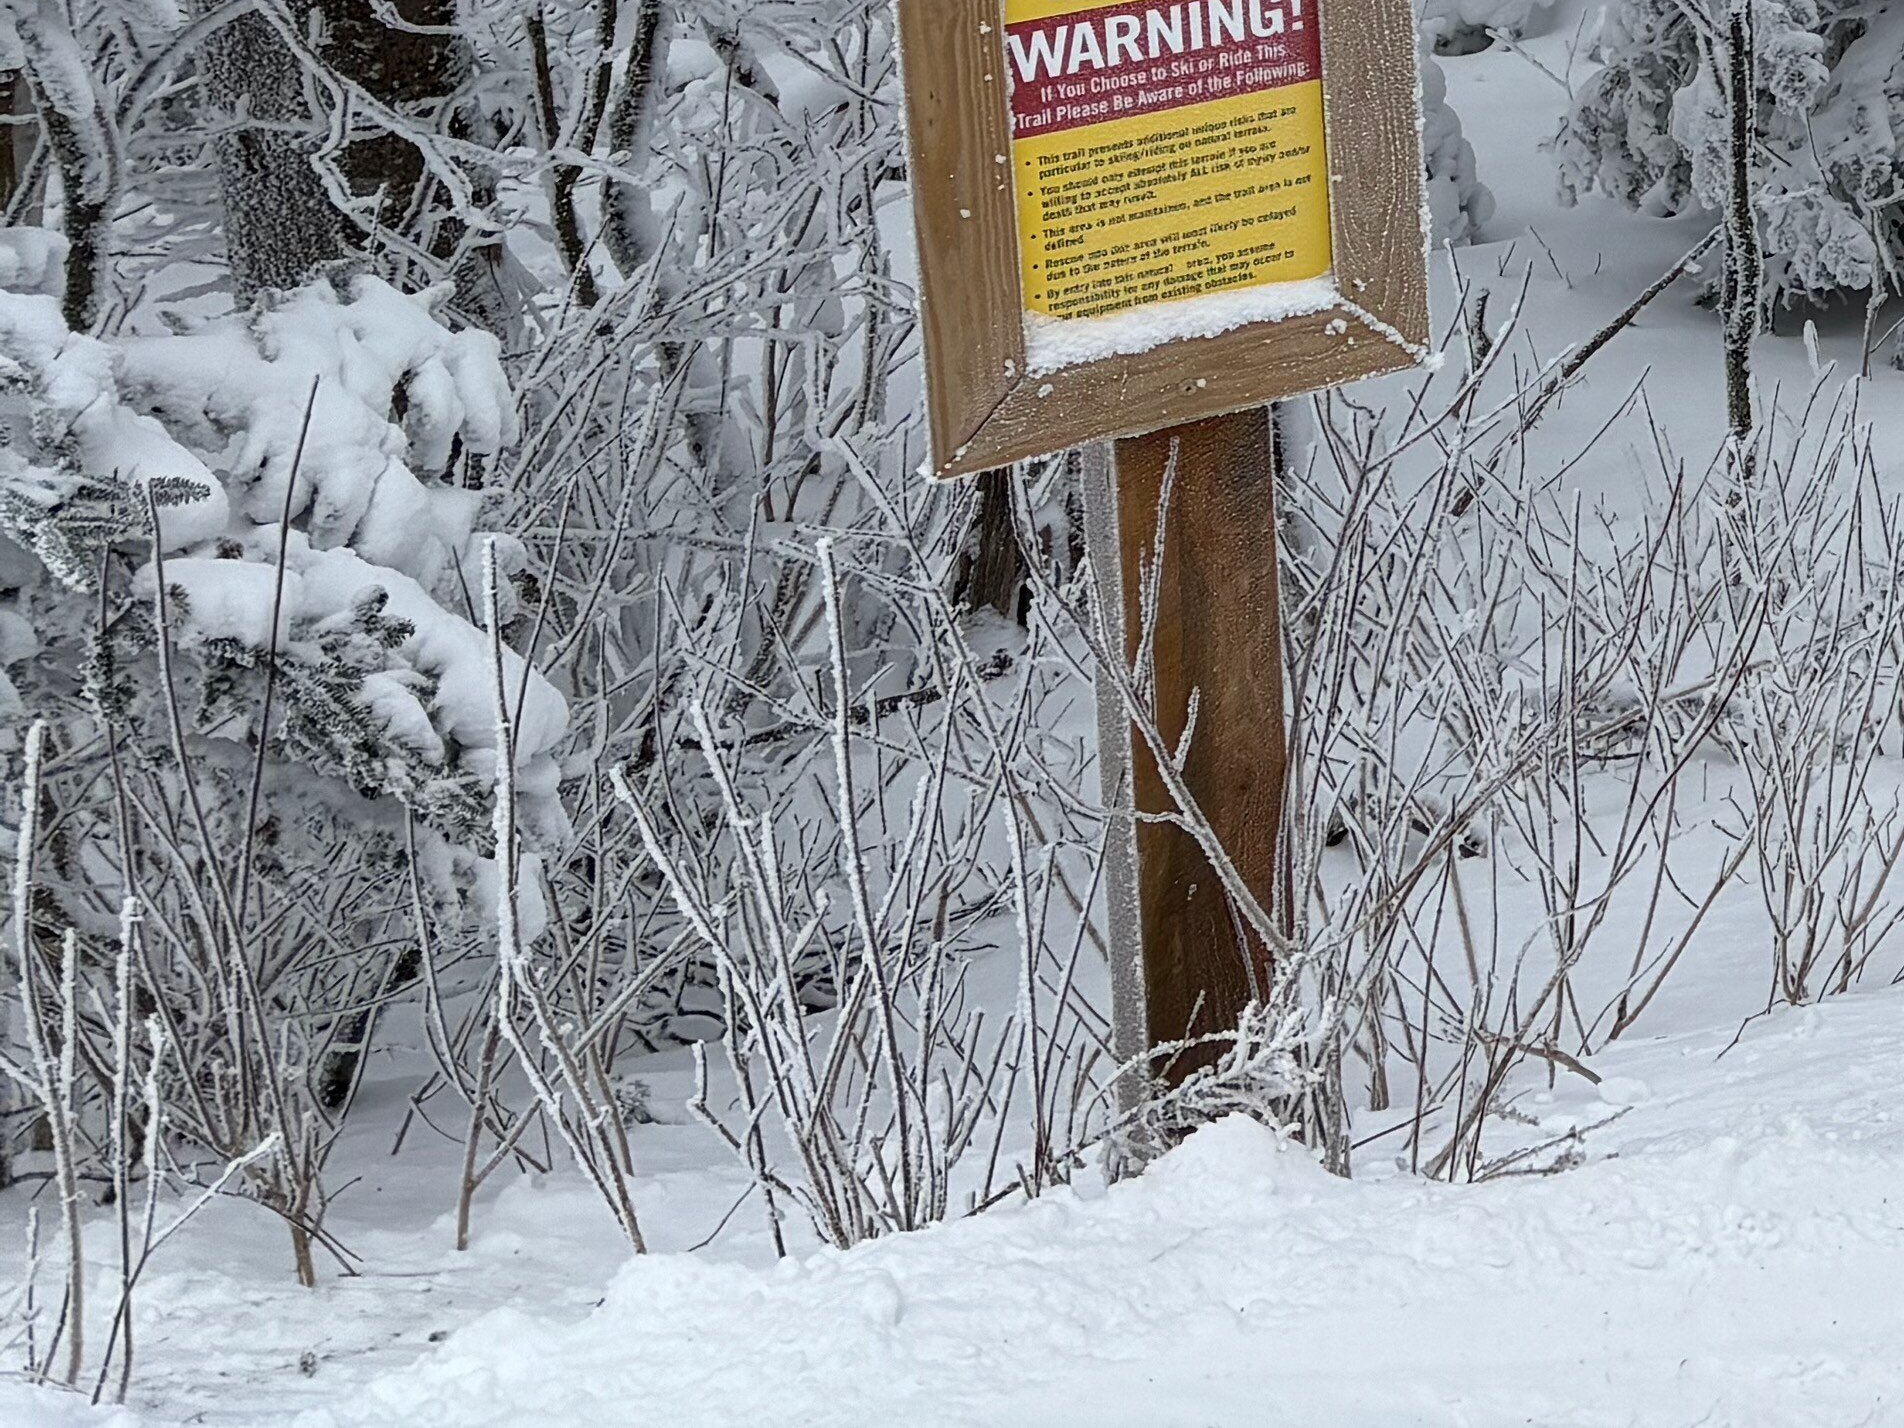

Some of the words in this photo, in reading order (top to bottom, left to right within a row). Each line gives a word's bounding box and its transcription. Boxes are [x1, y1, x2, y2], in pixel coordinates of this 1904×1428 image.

[1041, 86, 1052, 102] If
[1057, 82, 1085, 99] You
[1090, 72, 1146, 93] Choose
[1151, 68, 1168, 80] to
[1171, 60, 1194, 77] Ski
[1200, 57, 1213, 72] or
[1219, 49, 1251, 70] Ride
[1257, 44, 1286, 60] This
[1017, 109, 1051, 128] Trail
[1056, 100, 1108, 121] Please
[1114, 95, 1133, 110] Be
[1138, 86, 1182, 106] Aware
[1188, 82, 1202, 95] of
[1208, 75, 1231, 92] the
[1236, 62, 1310, 86] Following:
[1038, 153, 1060, 166] This
[1062, 148, 1085, 160] trail
[1088, 141, 1133, 157] presents
[1039, 161, 1090, 180] particular
[1195, 132, 1230, 146] natural
[1040, 186, 1060, 196] You
[1081, 191, 1091, 200] to
[1190, 166, 1208, 178] ALL
[1042, 228, 1065, 238] This
[1109, 214, 1126, 226] not
[1215, 193, 1231, 202] the
[1234, 186, 1255, 198] trail
[1043, 208, 1072, 222] death
[1075, 203, 1096, 214] that
[1070, 267, 1080, 276] to
[1140, 252, 1150, 260] of
[1141, 280, 1160, 292] any
[1206, 264, 1226, 276] that
[1229, 260, 1250, 270] may
[1047, 289, 1060, 300] By
[1077, 298, 1131, 318] equipment
[1134, 294, 1158, 305] from
